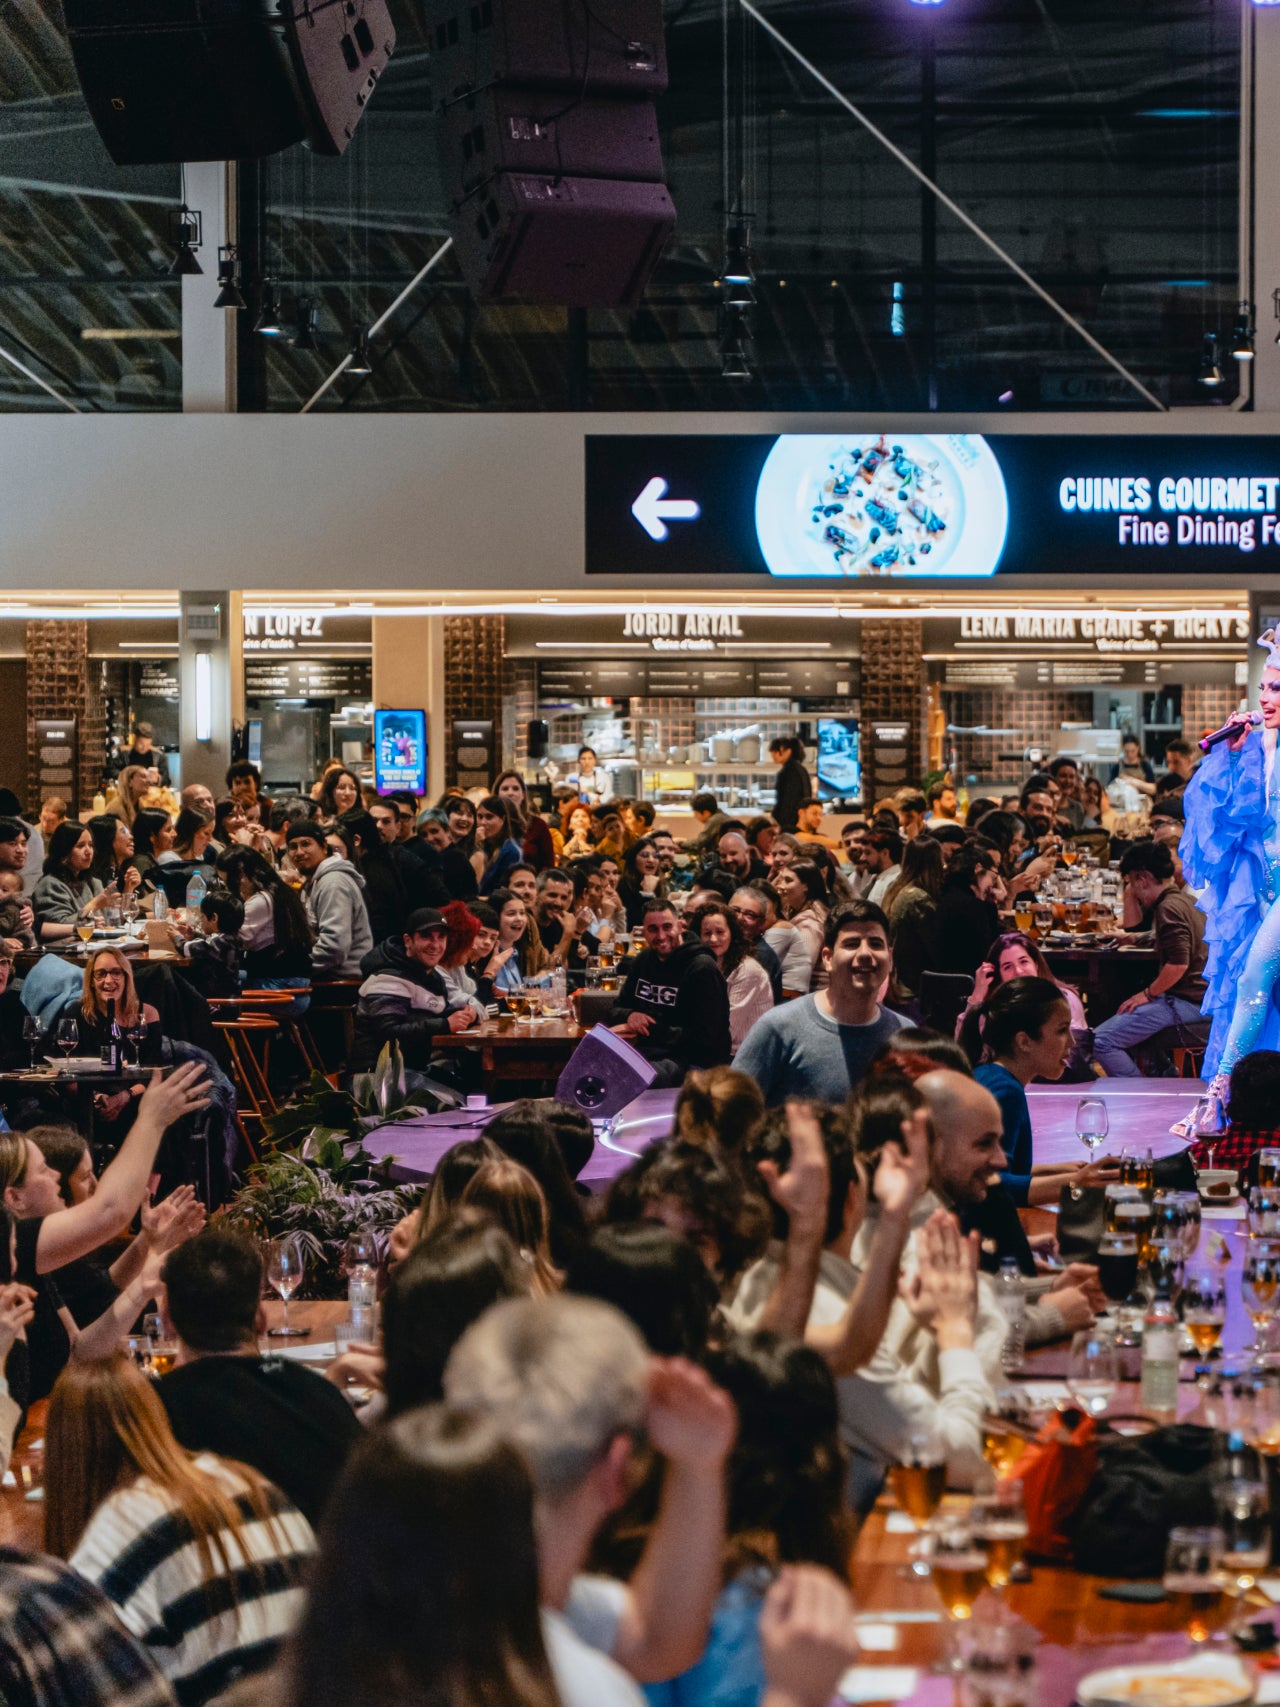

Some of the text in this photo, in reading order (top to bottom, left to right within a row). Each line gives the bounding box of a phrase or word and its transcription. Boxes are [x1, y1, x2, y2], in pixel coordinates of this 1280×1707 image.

[1059, 477, 1151, 510] CUINES
[1158, 477, 1279, 510] GOURMET
[1118, 515, 1170, 545] Fine
[1177, 515, 1255, 552] Dining
[623, 613, 744, 636] JORDI ARTAL
[960, 615, 1009, 638] LENA
[1014, 615, 1077, 638] MARIA
[1173, 617, 1249, 638] RICKYS
